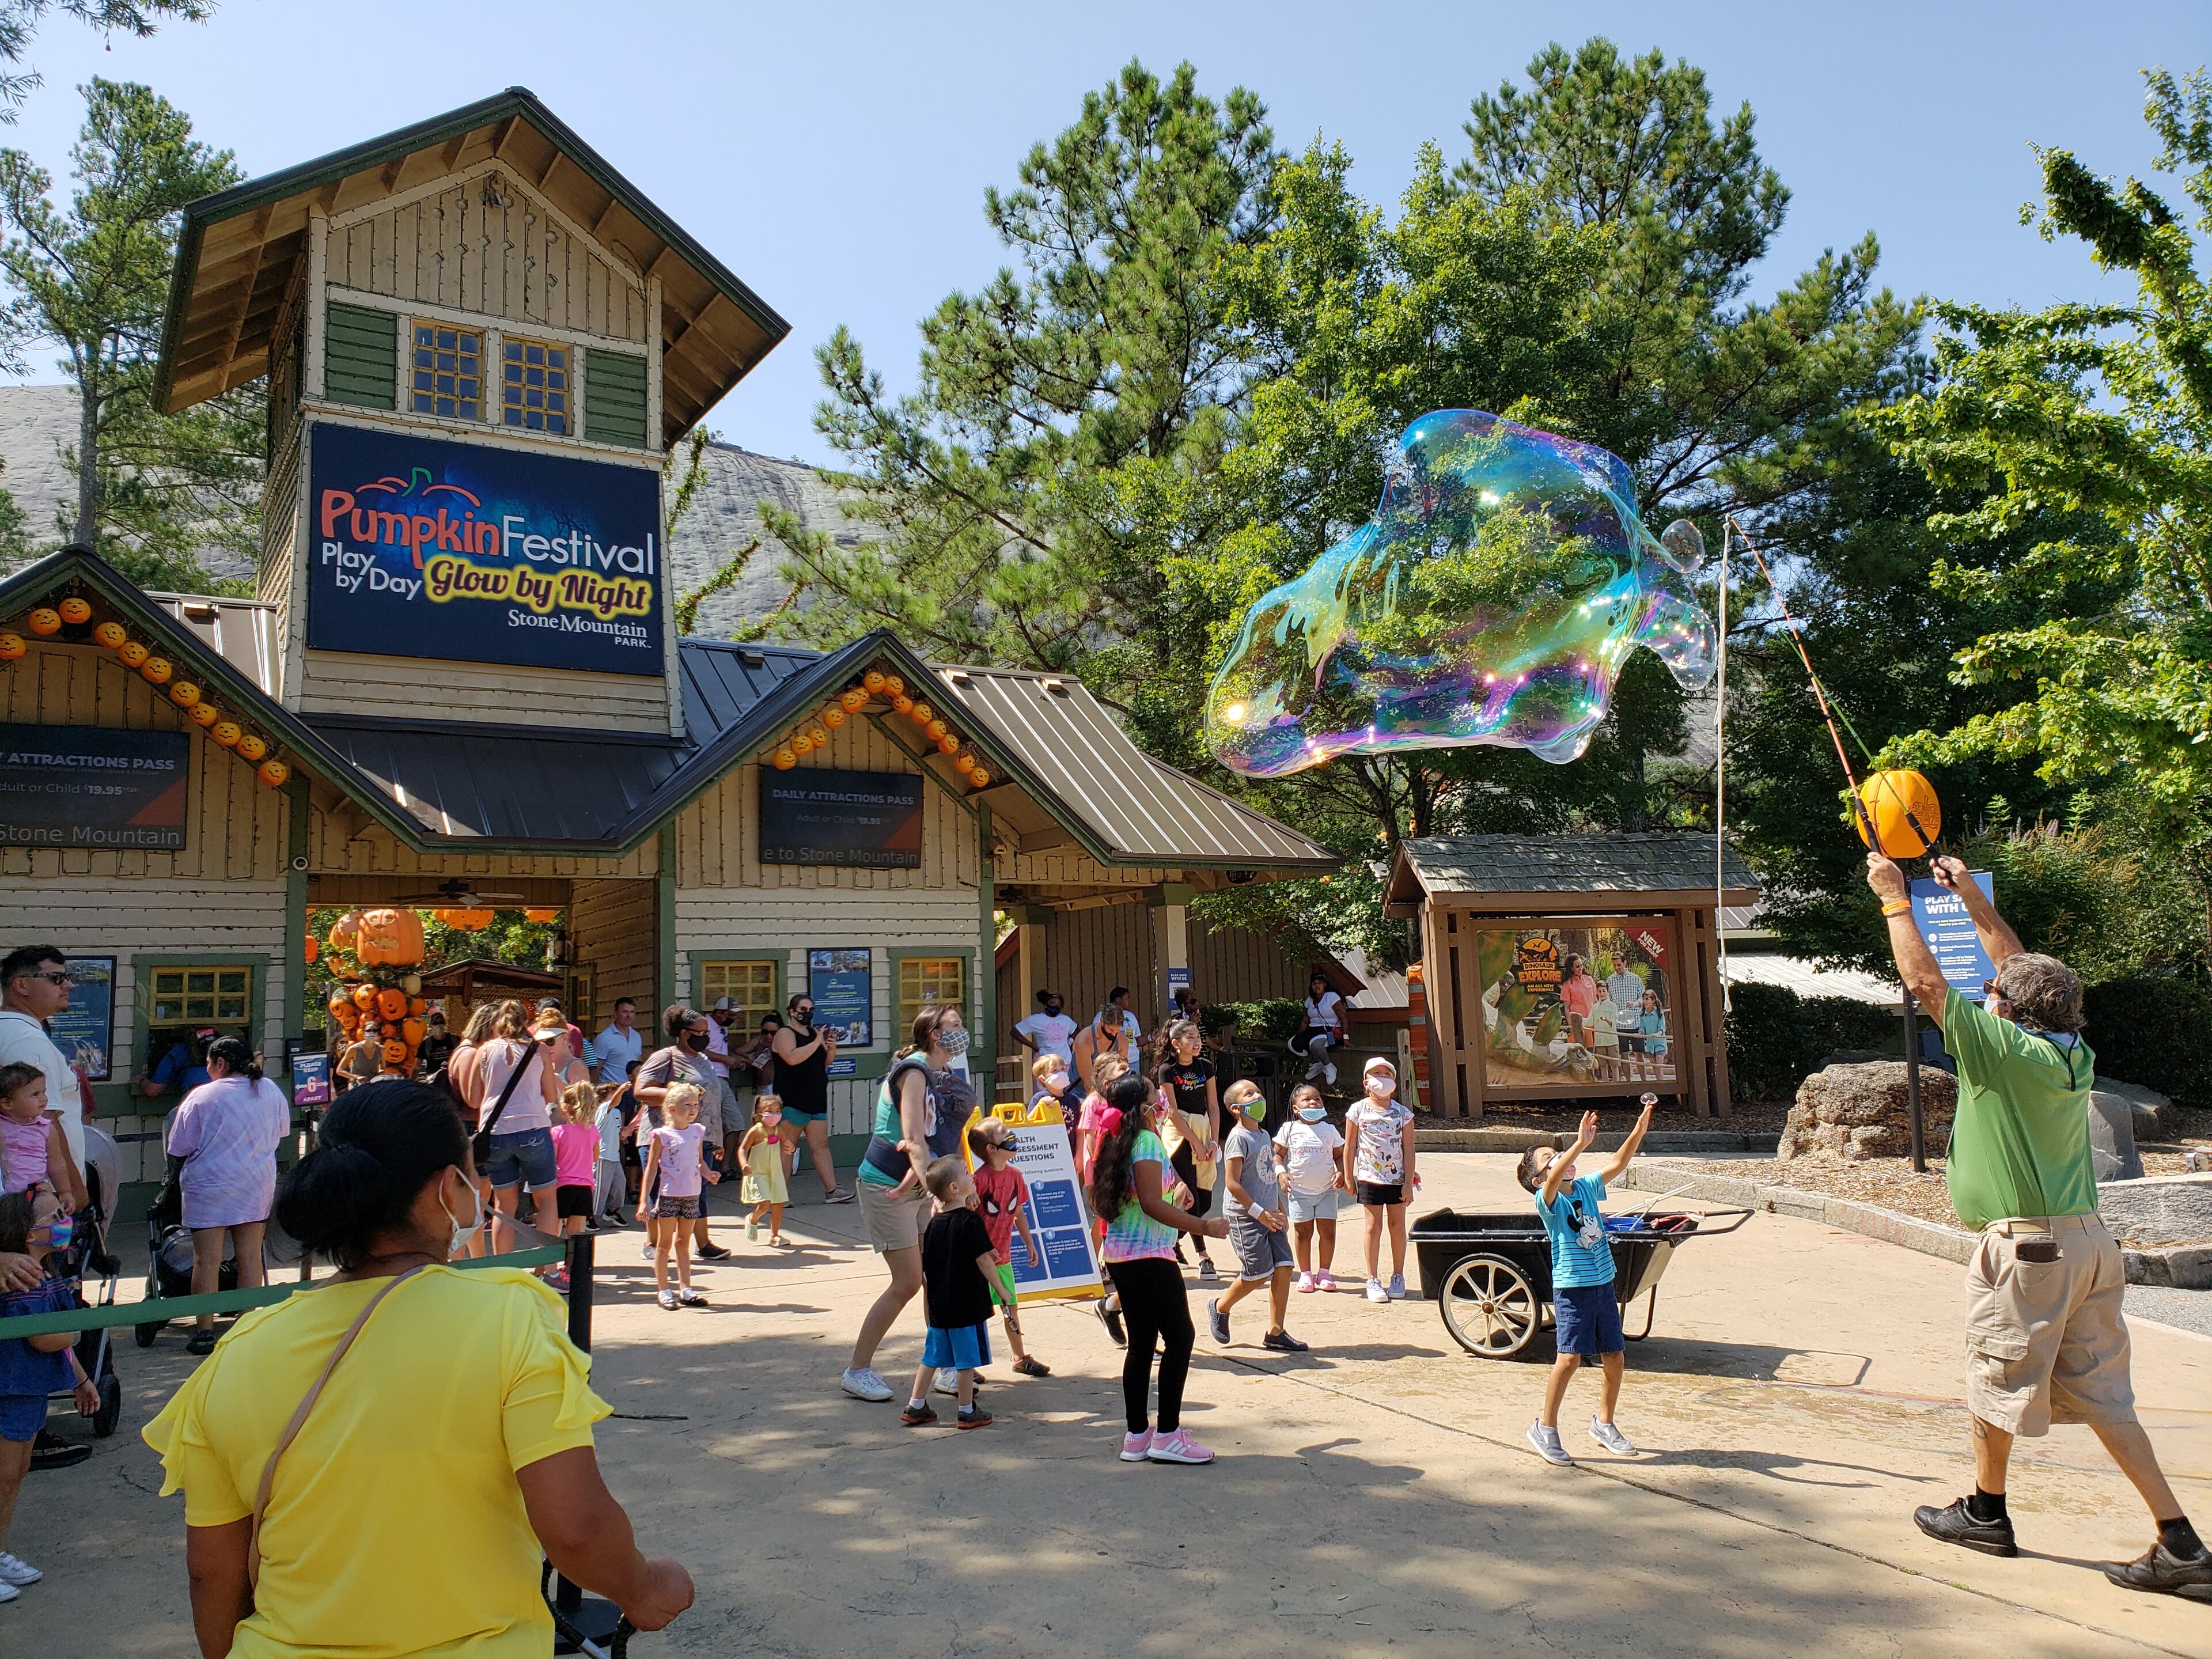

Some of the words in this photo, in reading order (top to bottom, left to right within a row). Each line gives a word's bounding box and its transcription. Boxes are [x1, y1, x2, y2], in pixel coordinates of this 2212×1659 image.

[321, 489, 499, 570] Pumpkin
[502, 516, 654, 575] Festival
[322, 541, 376, 575] Play
[336, 567, 363, 594] by
[370, 567, 423, 600] Day
[430, 560, 509, 596] Glow
[516, 571, 553, 608] by
[560, 574, 646, 614] Night
[7, 752, 128, 768] ATTRACTIONS
[132, 758, 175, 770] PASS
[0, 782, 25, 791] dult
[46, 783, 79, 793] Child
[772, 789, 806, 799] DAILY
[809, 791, 885, 804] ATTRACTIONS
[887, 796, 914, 805] PASS
[796, 814, 820, 823] Adult
[833, 816, 854, 824] Child
[73, 826, 180, 844] Mountain
[779, 849, 794, 859] to
[800, 847, 844, 862] Stone
[850, 849, 917, 864] Mountain
[1925, 895, 1950, 904] PLAY
[1925, 903, 1959, 914] WITH
[1637, 937, 1647, 948] FOR
[1645, 945, 1658, 959] 2020!
[1640, 931, 1664, 954] NEW
[1518, 970, 1561, 982] EXPLORE
[1017, 1143, 1059, 1152] SESSMENT
